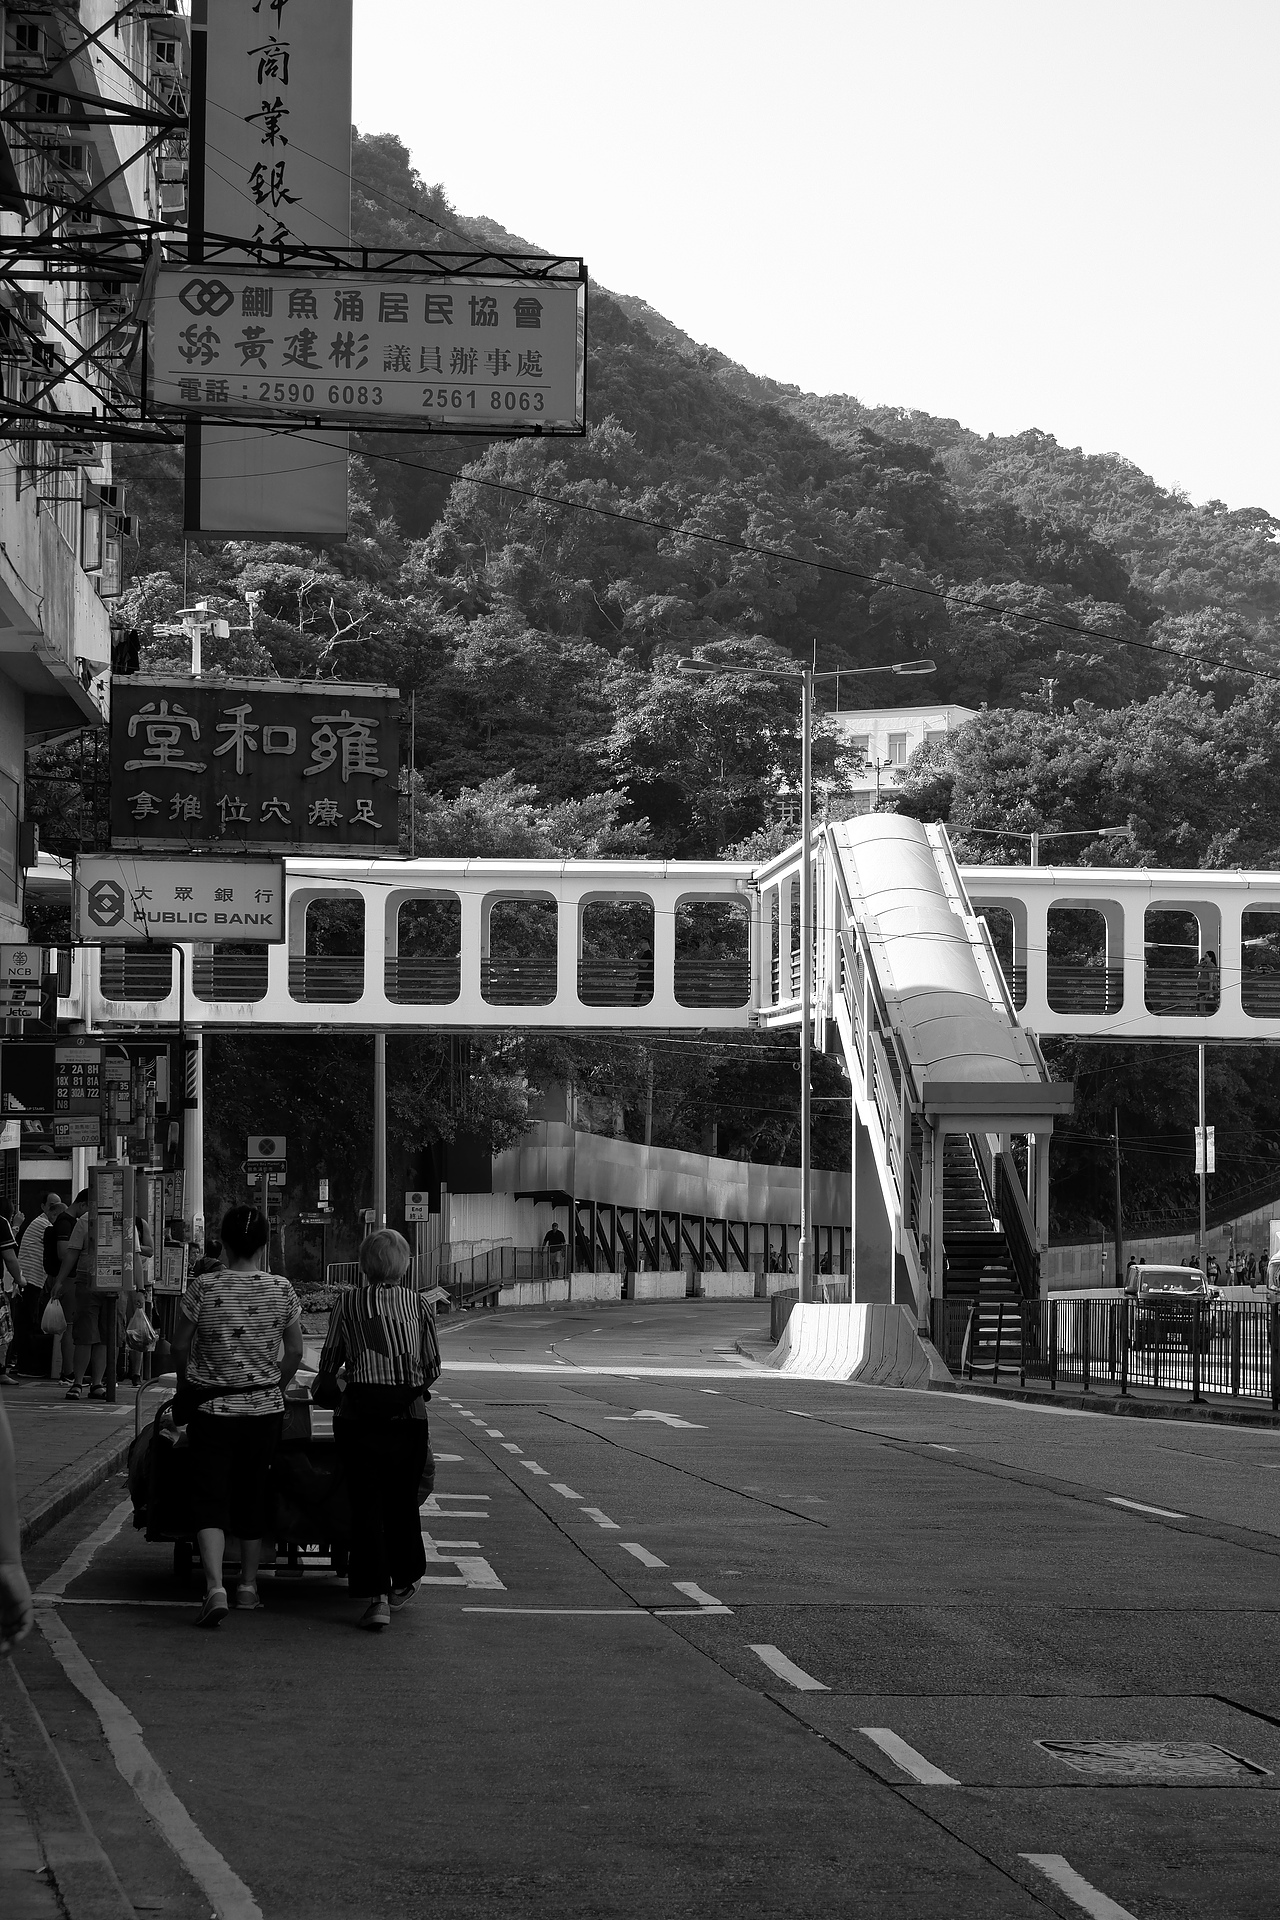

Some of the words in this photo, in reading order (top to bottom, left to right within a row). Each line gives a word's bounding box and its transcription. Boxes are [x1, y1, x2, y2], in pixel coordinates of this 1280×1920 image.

[241, 286, 544, 329] 鰂魚涌居民協會
[382, 344, 544, 379] 議員辦事處
[258, 381, 316, 405] 2590
[327, 384, 384, 406] 6083
[421, 388, 477, 409] 2561
[489, 391, 545, 412] 8063
[133, 910, 208, 924] PUBLIC
[214, 912, 274, 925] BANK
[8, 967, 32, 976] NCB
[59, 1064, 66, 1074] 2
[71, 1064, 84, 1074] 2A
[87, 1064, 99, 1074] 8H
[56, 1076, 69, 1086] 18X
[73, 1076, 83, 1086] 81
[86, 1076, 99, 1086] 81A
[57, 1088, 68, 1098] 82
[70, 1088, 85, 1098] 302A
[86, 1088, 100, 1098] 722
[56, 1100, 69, 1109] N8
[55, 1125, 69, 1135] 19P
